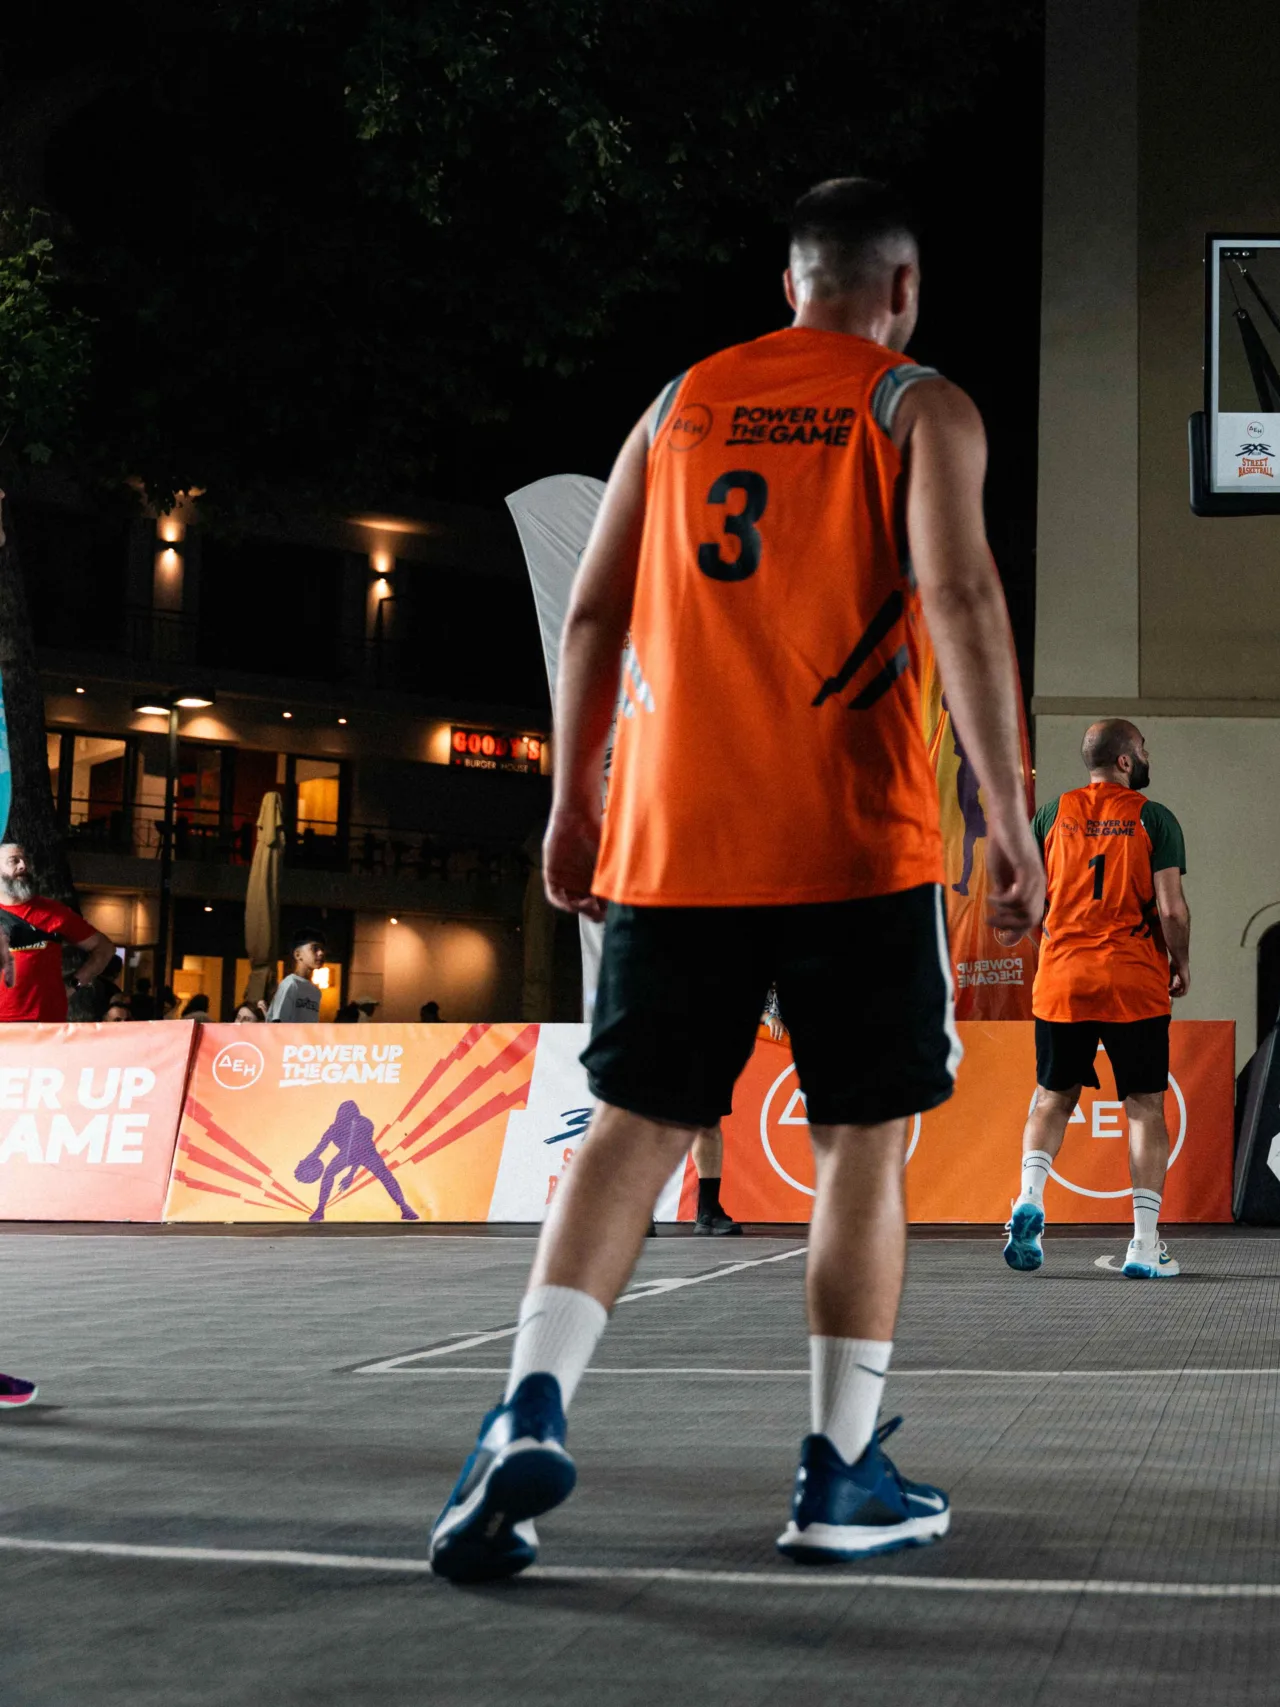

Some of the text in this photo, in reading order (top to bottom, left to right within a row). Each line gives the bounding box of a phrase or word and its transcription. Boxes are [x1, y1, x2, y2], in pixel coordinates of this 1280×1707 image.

[734, 406, 855, 423] POWER UP
[732, 424, 851, 446] THE GAME
[1242, 457, 1268, 467] STREET
[1238, 466, 1274, 478] BASKETBALL
[697, 469, 769, 582] 3
[464, 758, 529, 774] BURGER HOUSE
[1086, 820, 1120, 828] POWER
[1102, 828, 1134, 836] GAME
[1088, 854, 1105, 900] 1
[283, 1045, 404, 1062] POWER UP
[219, 1055, 256, 1077] ΔΕΗ
[283, 1063, 402, 1084] THE GAME
[78, 1067, 156, 1110] UP
